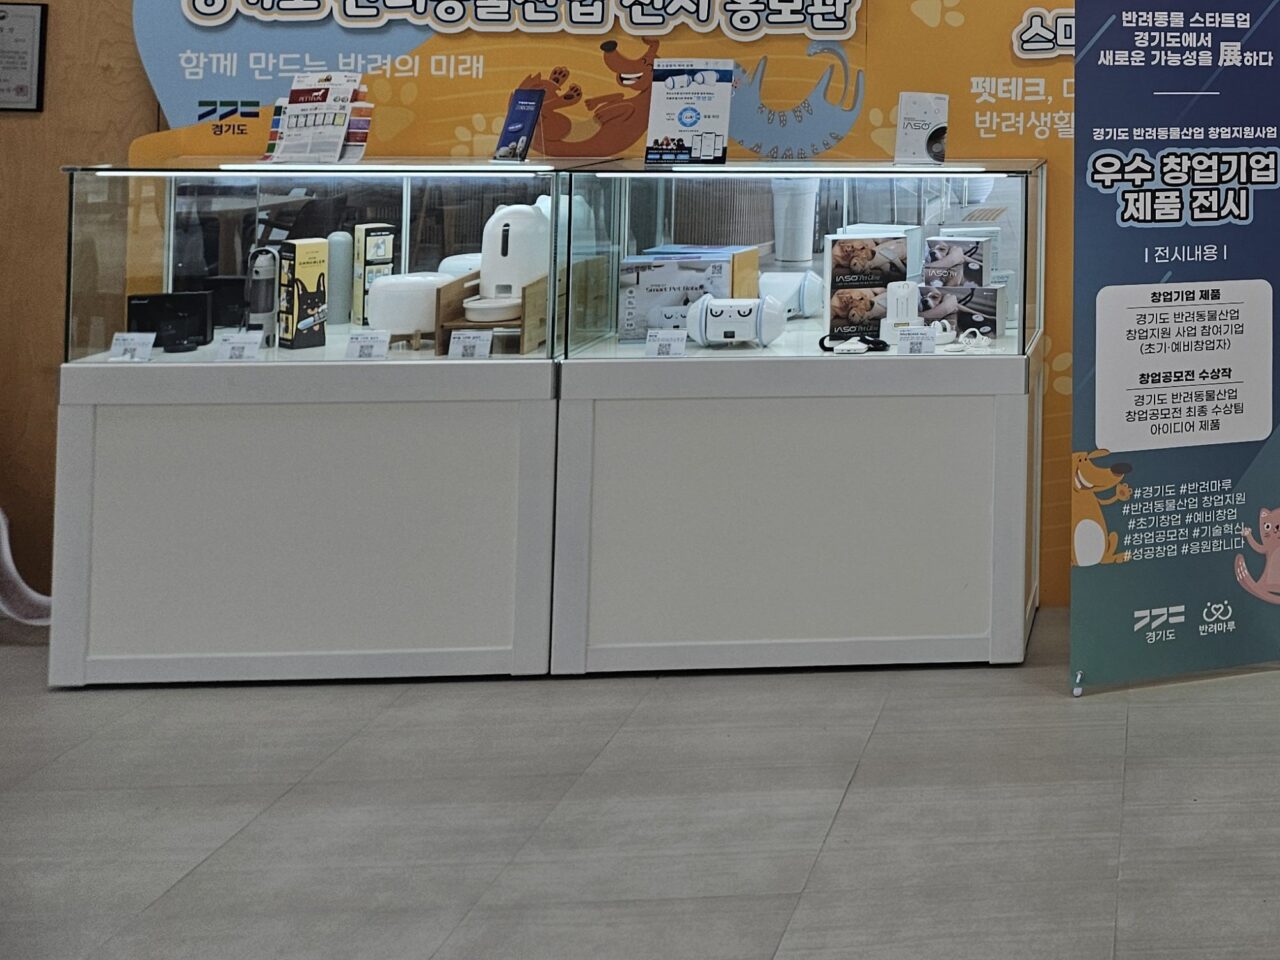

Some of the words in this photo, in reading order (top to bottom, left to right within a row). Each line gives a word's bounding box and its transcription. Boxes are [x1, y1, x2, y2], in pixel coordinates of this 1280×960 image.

[1121, 11, 1184, 27] 반려동물
[1189, 12, 1251, 28] 스타트업
[1134, 31, 1212, 47] 경기도에서
[1098, 50, 1145, 66] 새로운
[1150, 50, 1213, 66] 가능성을
[1218, 41, 1274, 67] 展하다
[178, 49, 237, 80] 함께
[430, 52, 484, 80] 미래
[970, 76, 1053, 104] 펫테크,
[211, 124, 248, 135] 경기도
[1092, 127, 1129, 140] 경기도
[1133, 127, 1204, 140] 반려동물산업
[1208, 126, 1278, 139] 창업지원사업
[1092, 154, 1154, 187] 우수
[1161, 152, 1277, 185] 창업기업
[1122, 189, 1183, 222] 제품
[1191, 188, 1251, 220] 전시
[1154, 244, 1218, 263] 전시내용
[1150, 289, 1195, 303] 창업기업
[1199, 288, 1221, 301] 제품
[1136, 312, 1169, 326] 경기도
[1173, 308, 1240, 324] 반려동물산업
[1125, 328, 1171, 341] 창업지원
[1175, 326, 1197, 339] 사업
[1200, 322, 1244, 337] 참여기업
[1138, 370, 1195, 385] 창업공모전
[1199, 367, 1232, 381] 수상작
[1134, 393, 1167, 407] 경기도
[1171, 388, 1238, 404] 반려동물산업
[1125, 409, 1182, 423] 창업공모전
[1186, 405, 1208, 418] 최종
[1211, 402, 1244, 416] 수상팀
[1150, 421, 1195, 435] 아이디어
[1199, 418, 1220, 432] 제품
[1134, 484, 1176, 499] #경기도
[1180, 479, 1232, 495] #반려마루
[1122, 496, 1198, 515] #반려동물산업
[1202, 492, 1246, 508] 창업지원
[1127, 513, 1181, 530] #초기창업
[1185, 508, 1238, 525] #예비창업
[1123, 528, 1189, 546] #창업공모전
[1193, 522, 1245, 539] #기술혁신
[1123, 544, 1178, 561] #성공창업
[1181, 537, 1245, 555] #응원합니다
[1145, 629, 1176, 643] 경기도
[1199, 621, 1236, 635] 반려마루
